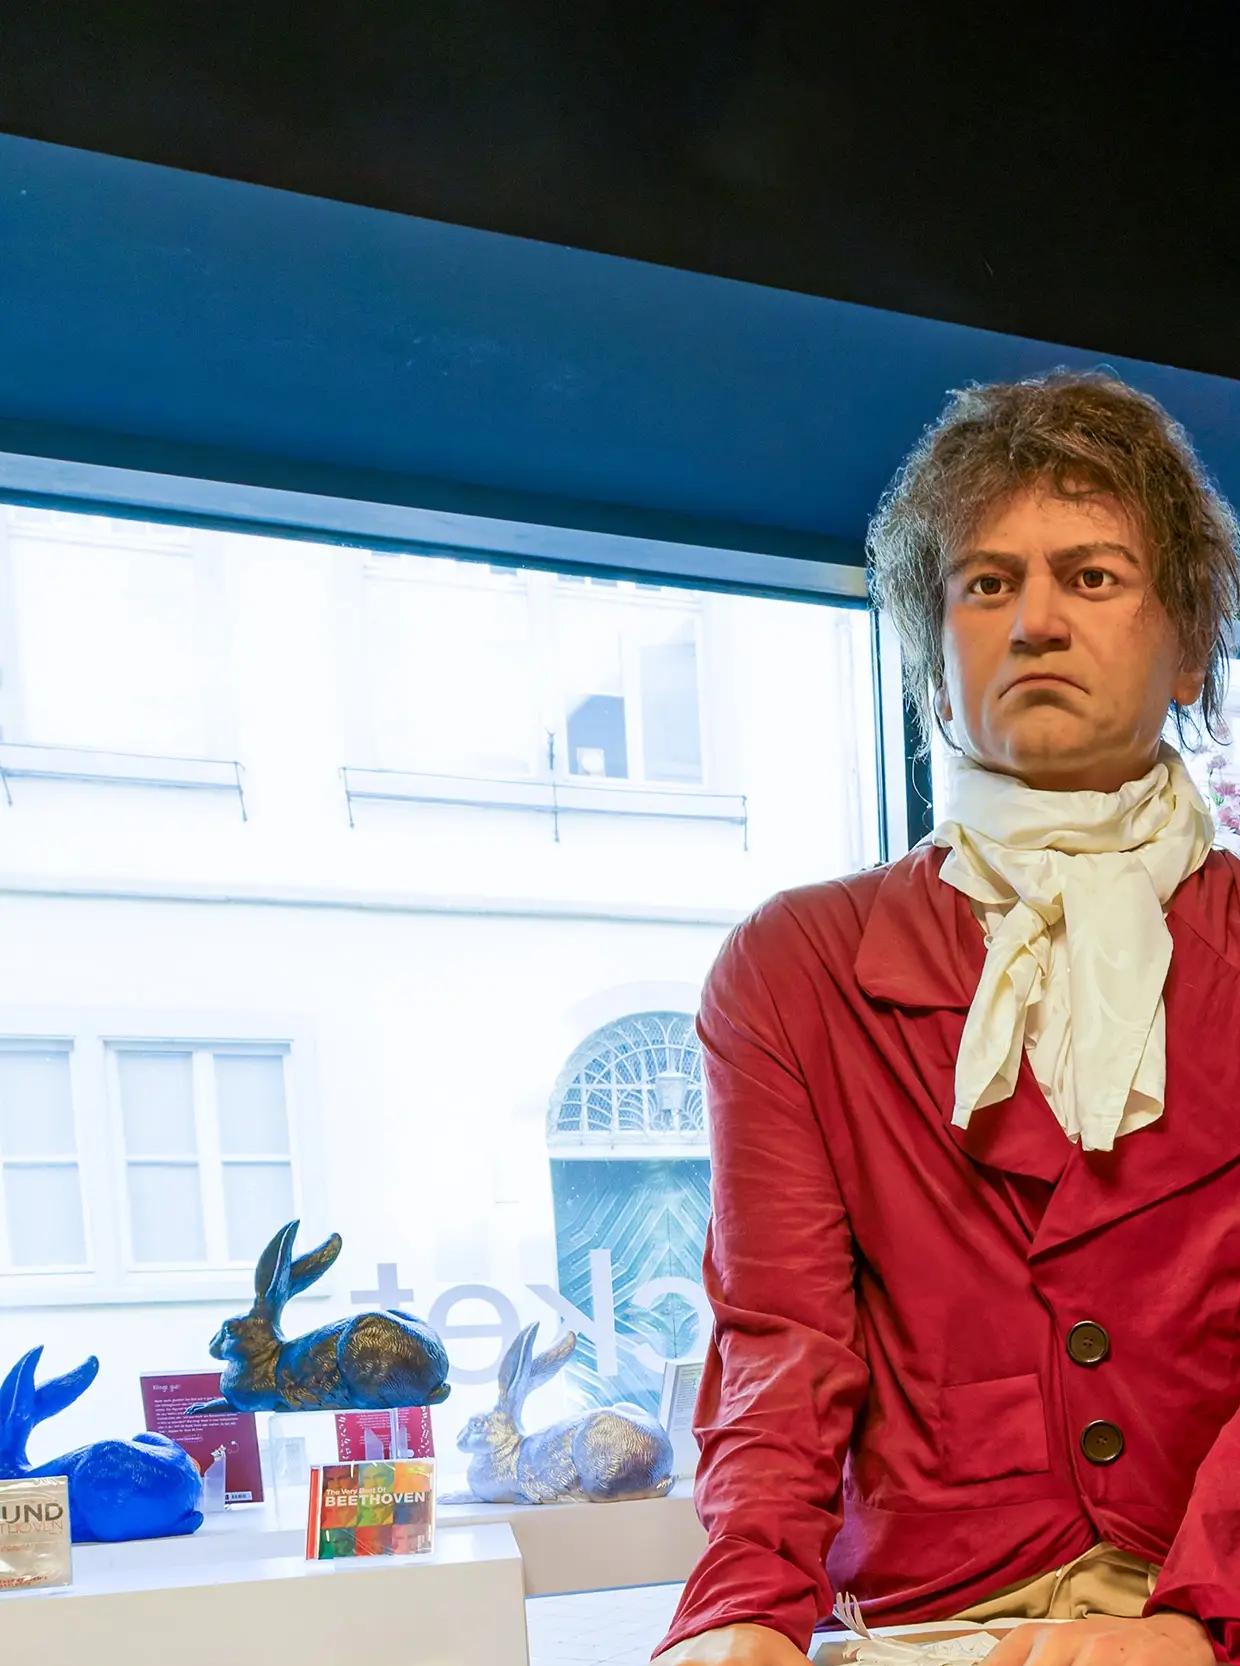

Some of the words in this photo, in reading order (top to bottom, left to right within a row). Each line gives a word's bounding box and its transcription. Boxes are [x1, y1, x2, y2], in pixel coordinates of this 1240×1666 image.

[326, 1488, 340, 1496] The
[340, 1487, 358, 1497] Very
[358, 1486, 377, 1494] Best
[325, 1491, 425, 1507] BEETHOVEN
